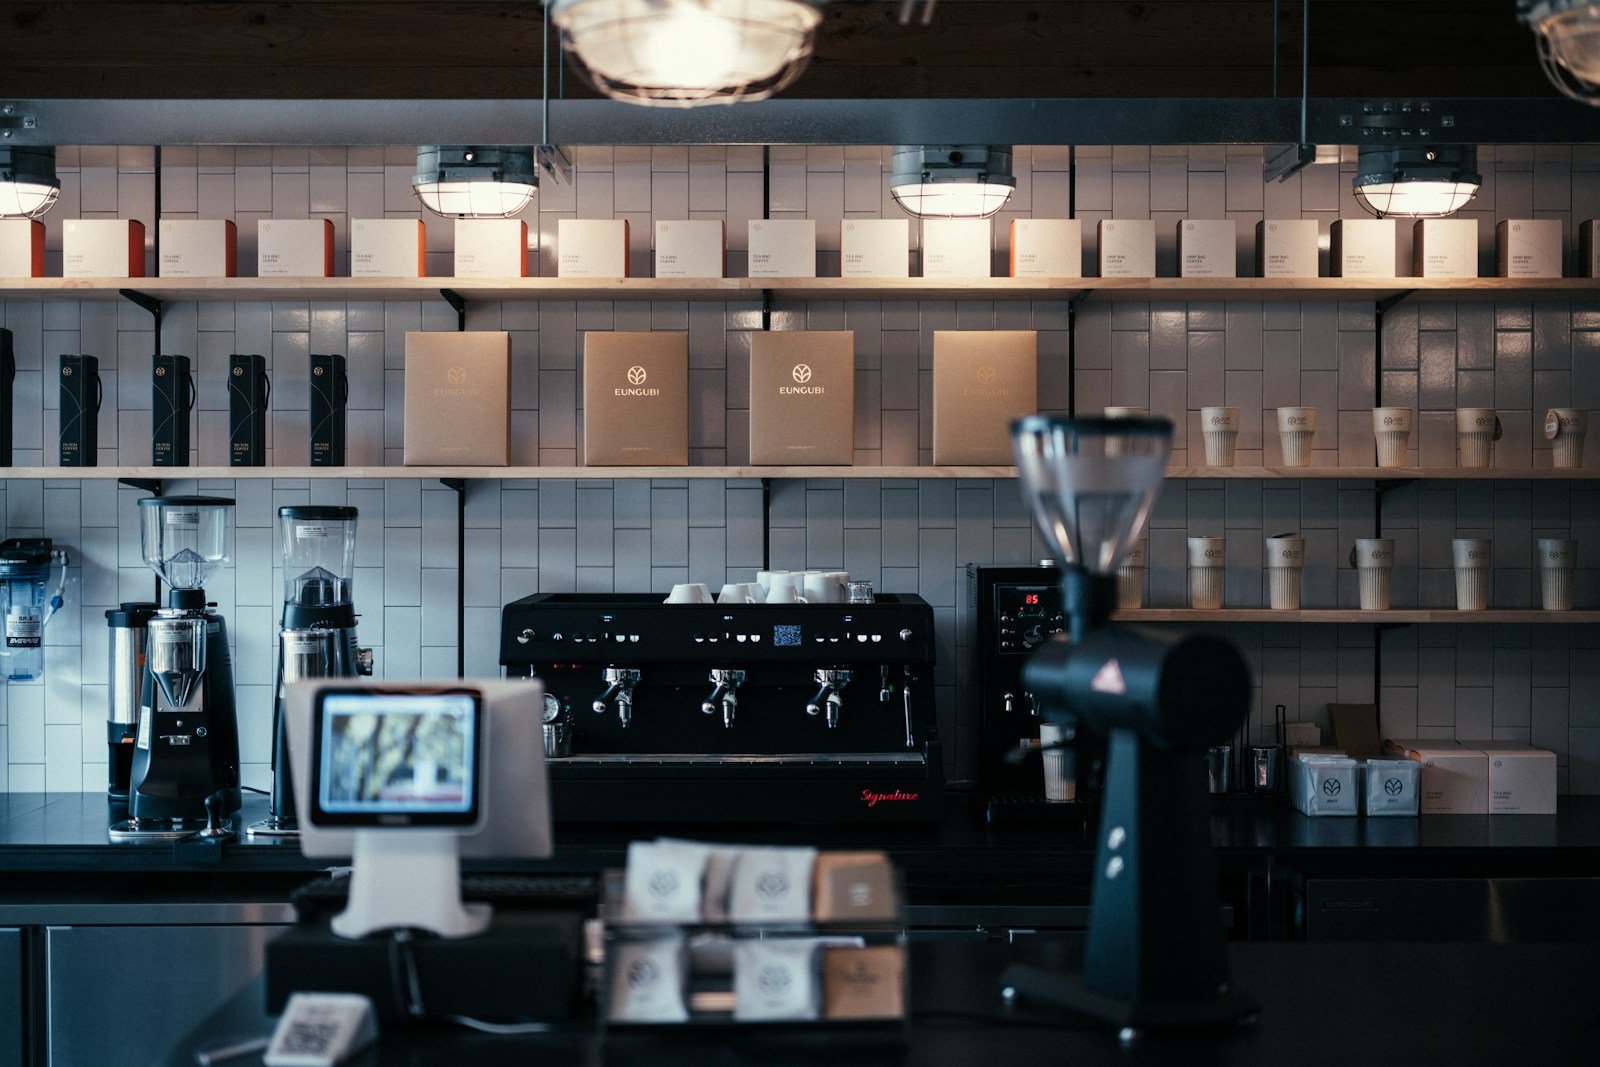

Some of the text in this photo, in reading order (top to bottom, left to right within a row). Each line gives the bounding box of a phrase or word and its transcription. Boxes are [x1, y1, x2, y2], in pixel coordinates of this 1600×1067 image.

[434, 388, 479, 396] EUNGUBI
[964, 388, 1008, 396] EUNGUBI
[862, 790, 919, 808] Signature
